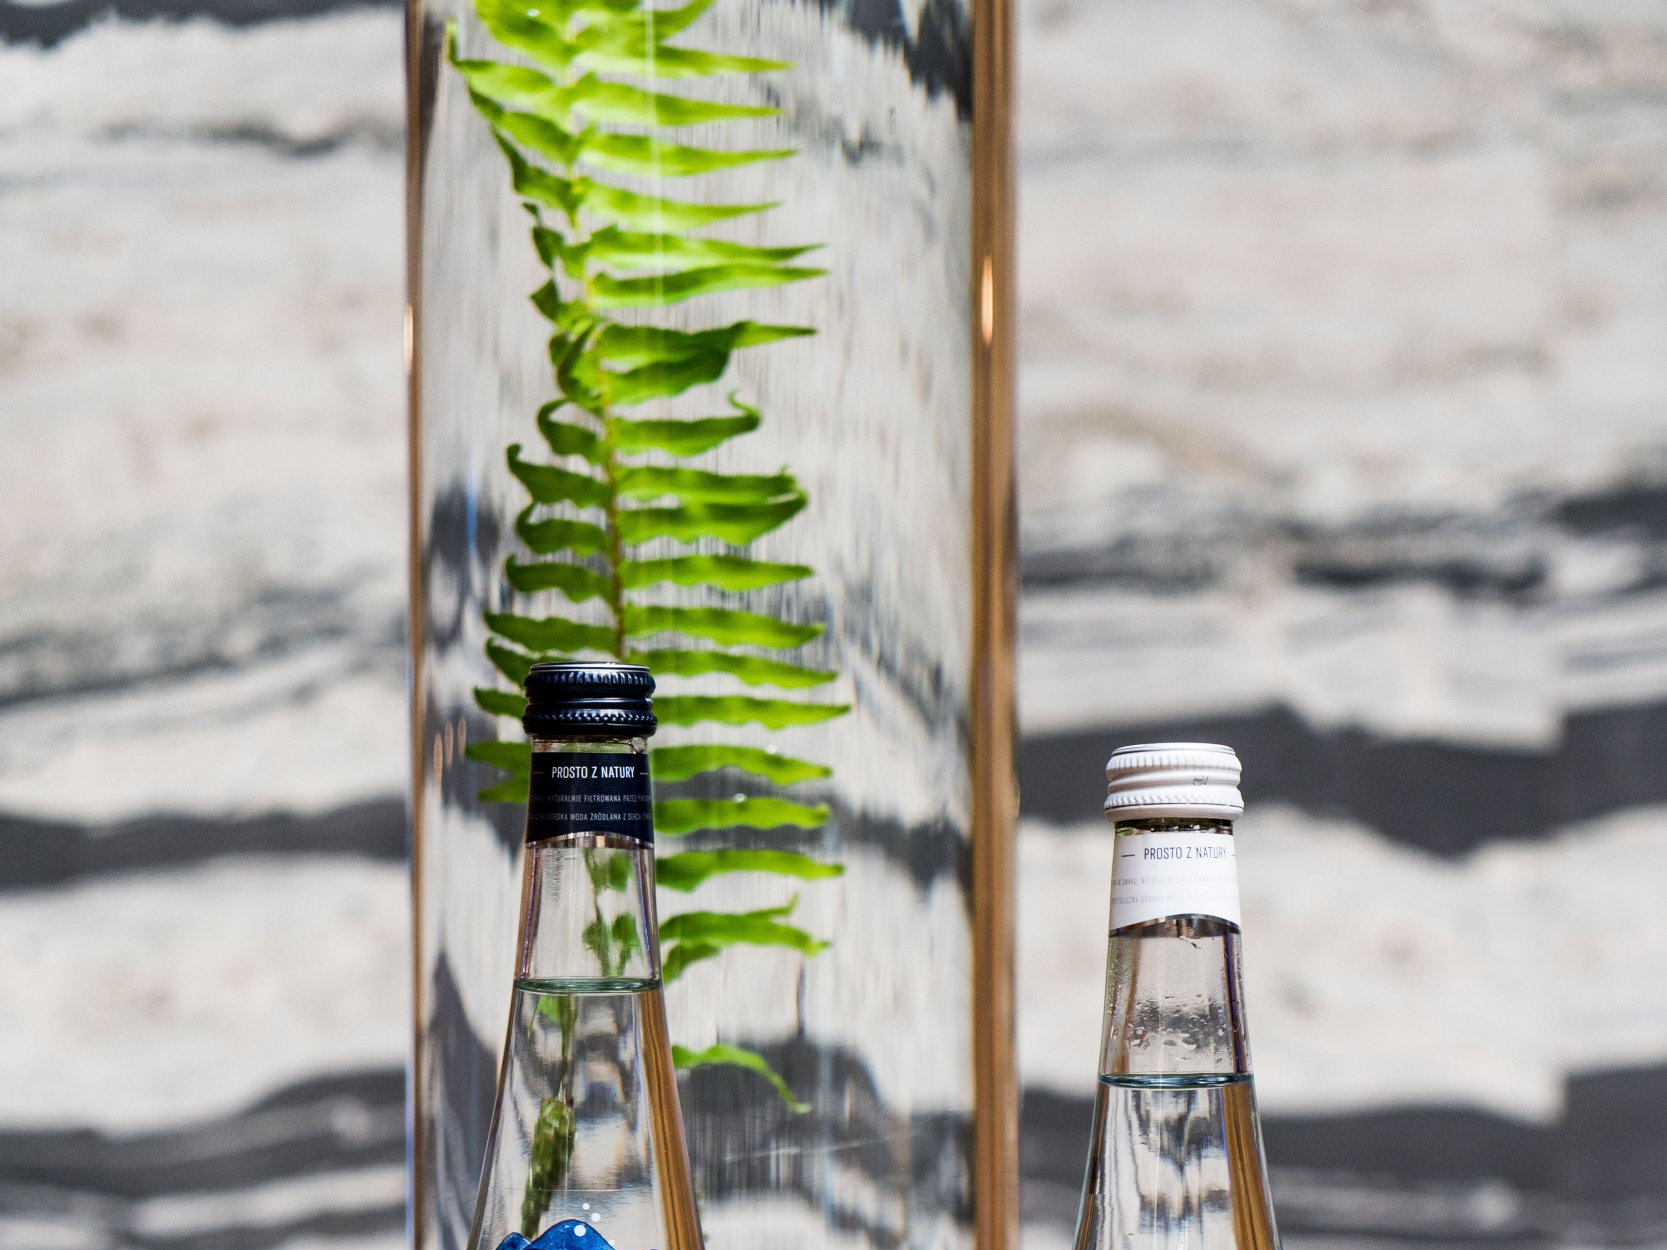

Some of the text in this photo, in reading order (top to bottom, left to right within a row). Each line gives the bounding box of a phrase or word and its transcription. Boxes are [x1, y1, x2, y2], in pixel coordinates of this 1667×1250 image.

[551, 766, 635, 778] PROSTO Z NATURY
[583, 794, 622, 803] FILTROWANA
[570, 812, 588, 821] WODA
[1144, 846, 1227, 860] PROSTO Z NATURY
